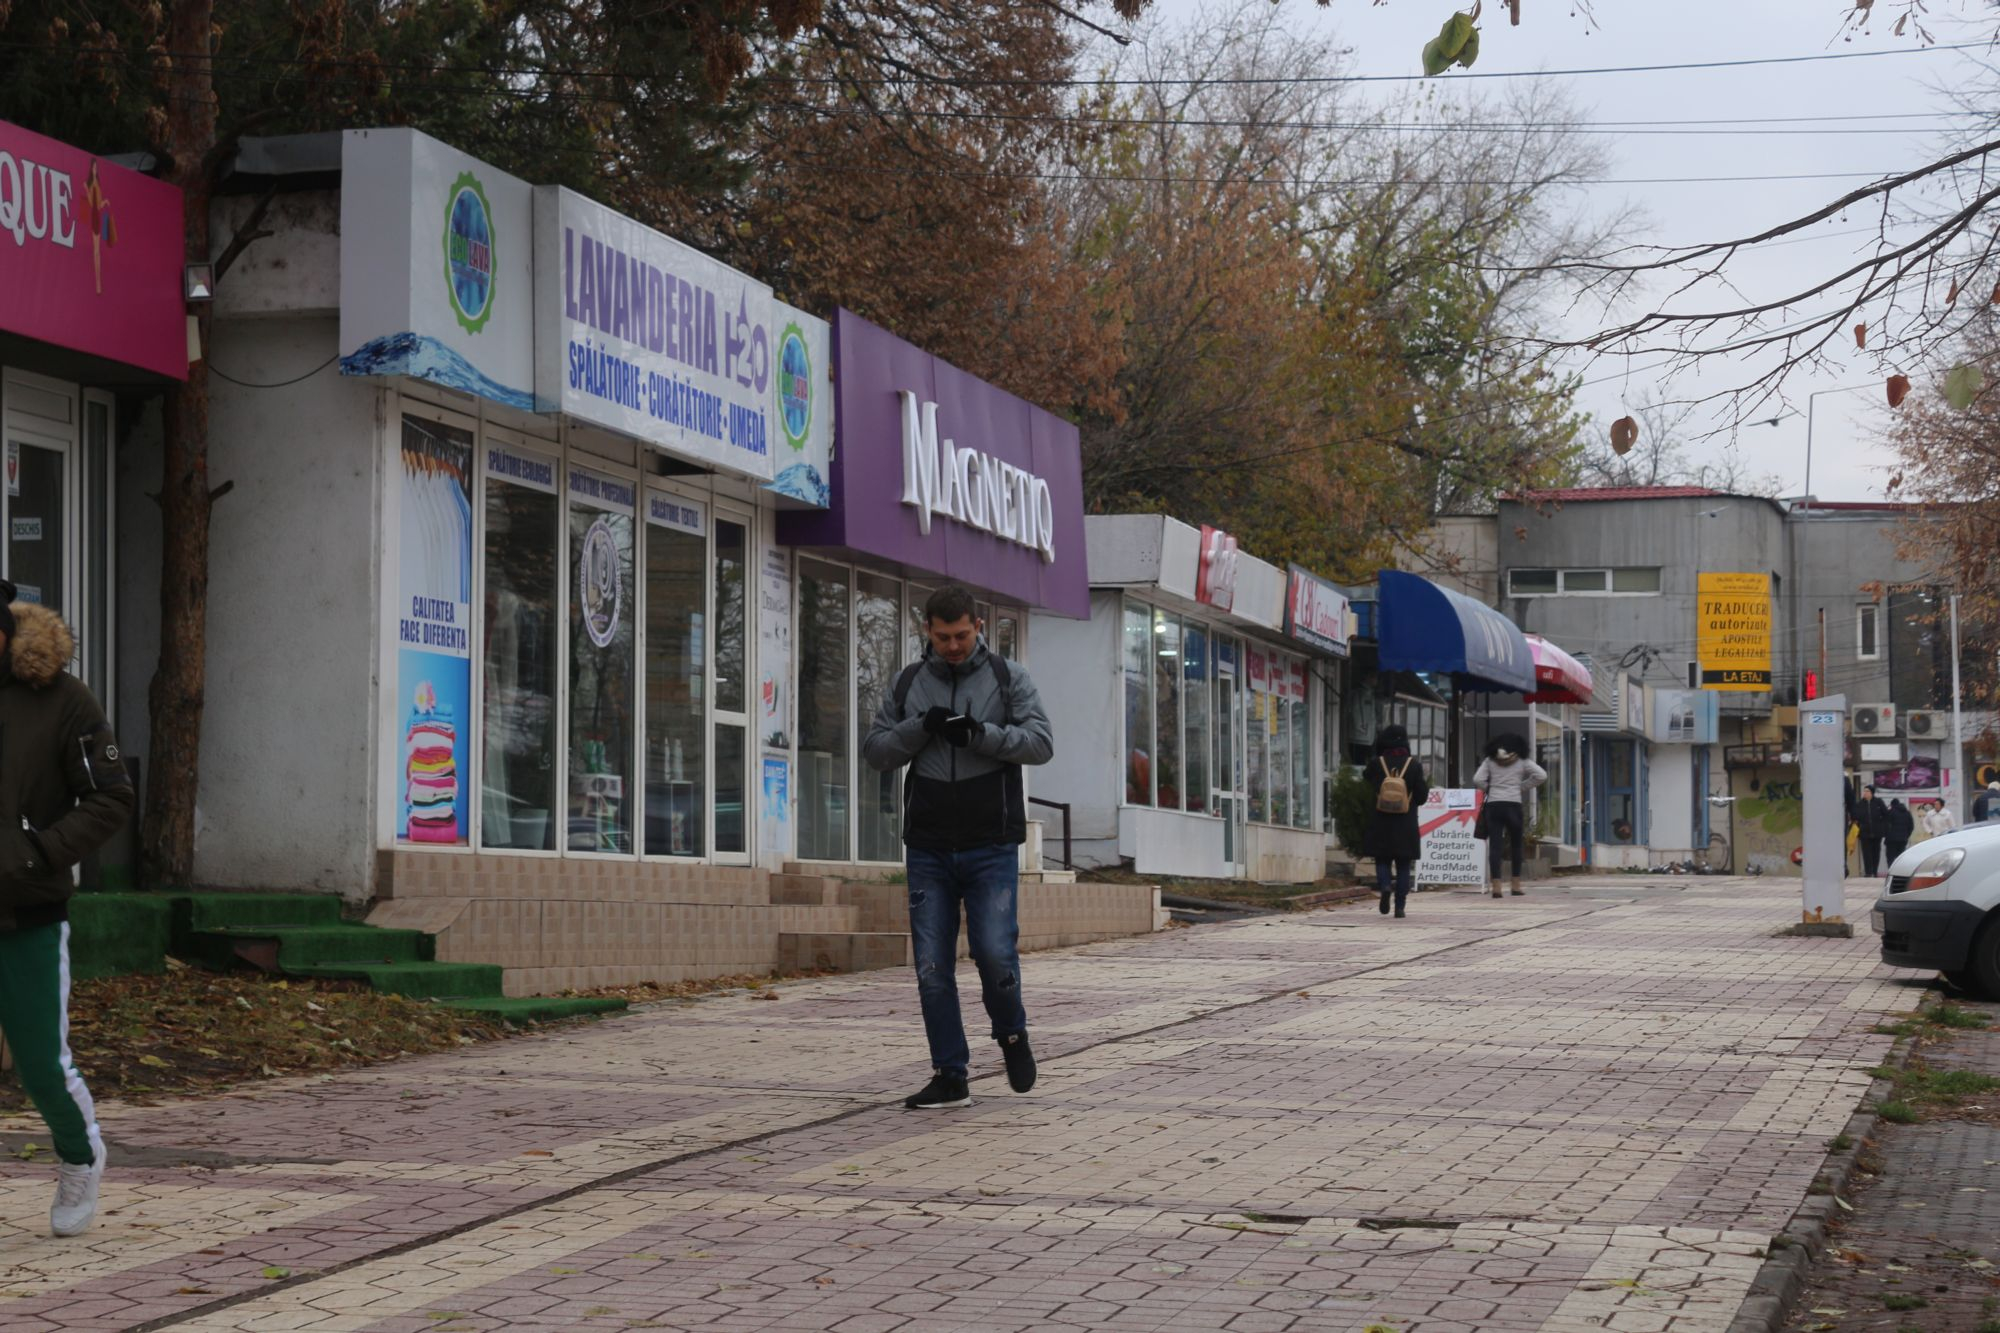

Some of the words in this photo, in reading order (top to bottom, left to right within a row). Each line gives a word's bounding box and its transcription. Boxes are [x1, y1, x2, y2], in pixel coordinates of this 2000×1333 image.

[468, 238, 491, 275] LAVA
[565, 227, 719, 377] LAVANDERIA
[569, 338, 641, 411] SPĂLĂTORIE
[729, 402, 767, 456] UMEDĂ
[14, 523, 40, 536] DESCHIS
[412, 595, 455, 623] CALITATEA
[400, 619, 420, 643] FACE
[423, 622, 467, 655] DIFERENȚA
[1723, 671, 1738, 682] LA
[1740, 671, 1763, 682] ETAJ
[1812, 715, 1834, 724] 23
[1426, 840, 1476, 850] Papetarie
[1430, 851, 1471, 861] Cadouri
[1421, 862, 1479, 872] HandMade
[1417, 873, 1440, 881] Arte
[1442, 873, 1482, 882] Plastice
